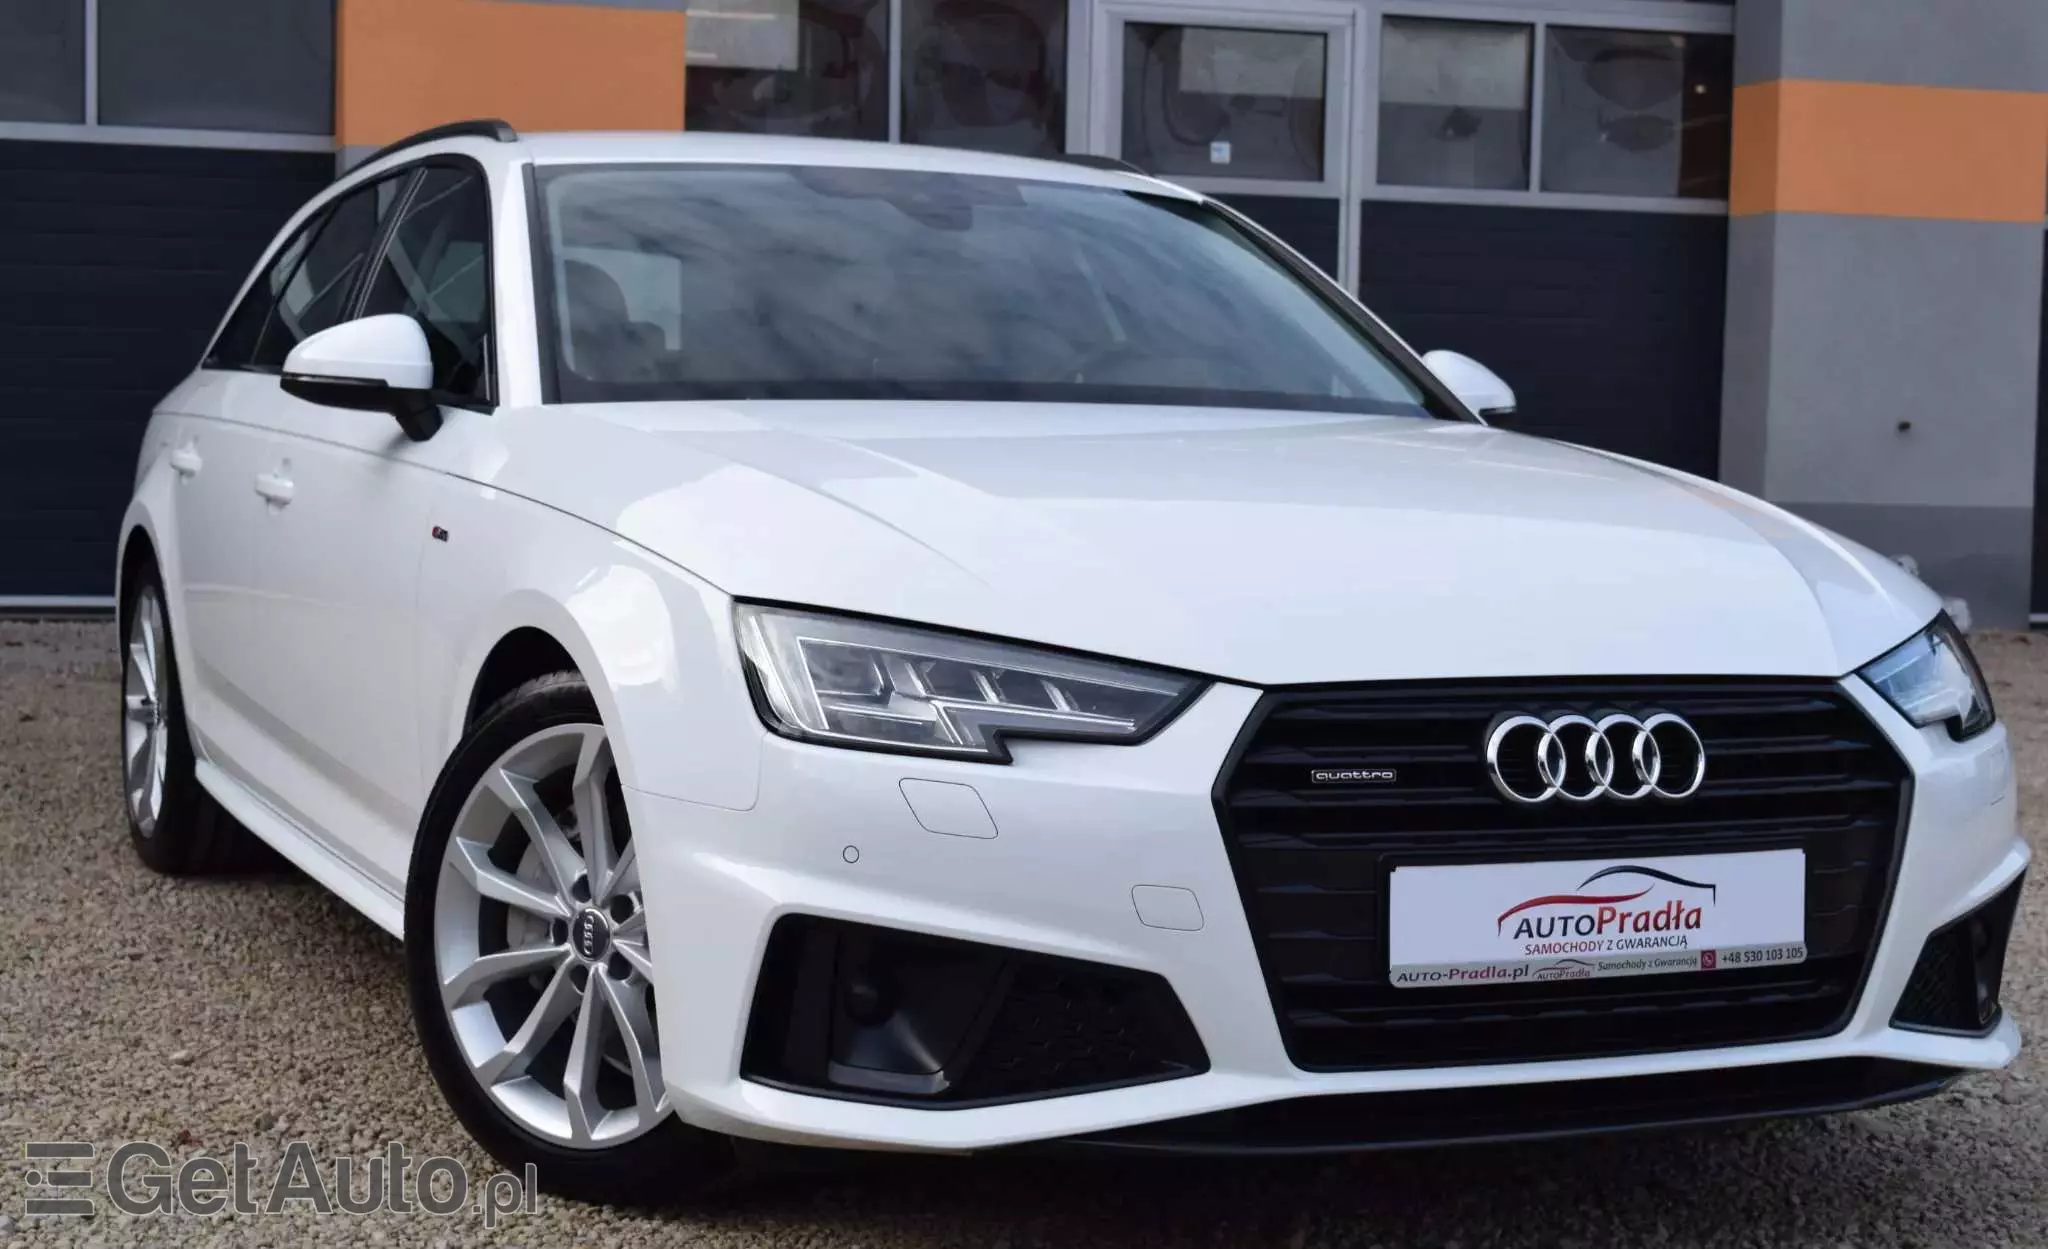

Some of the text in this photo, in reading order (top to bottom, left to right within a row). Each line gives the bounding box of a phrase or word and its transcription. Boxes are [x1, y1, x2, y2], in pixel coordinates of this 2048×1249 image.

[1316, 771, 1393, 782] quattro
[1513, 900, 1702, 939] AUTOPradła
[1525, 935, 1688, 955] SAMOCHODY Z GWARANCJĄ
[1597, 958, 1648, 971] Samochody
[1654, 956, 1697, 969] Gwarancją
[1722, 946, 1803, 964] +48 530 103 105
